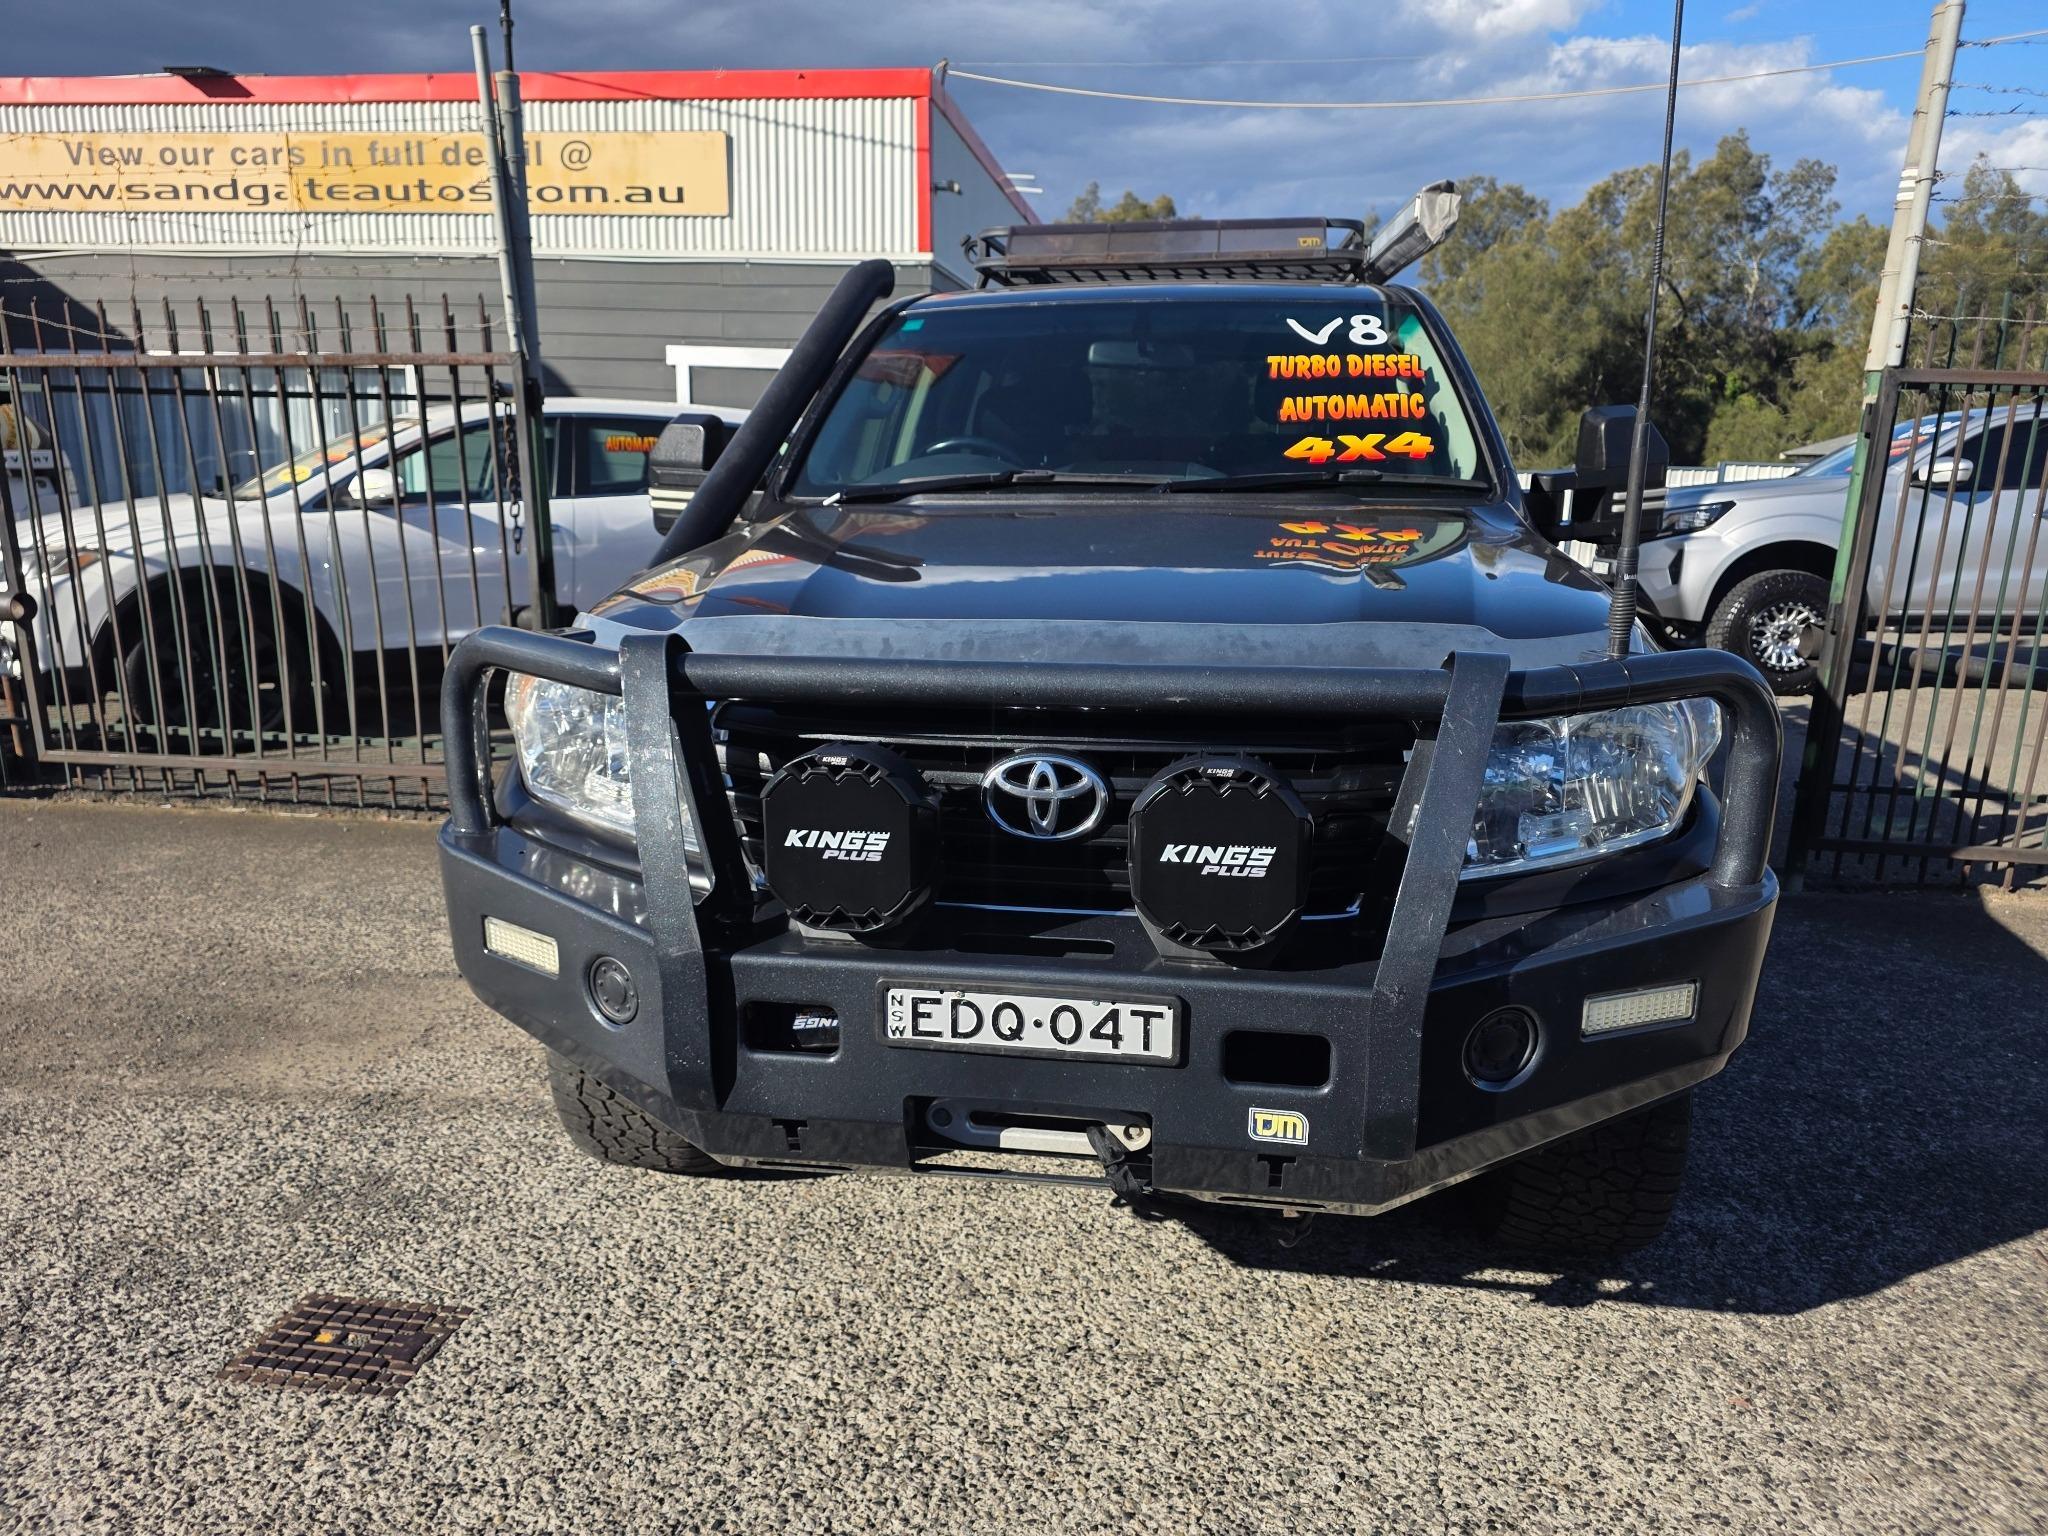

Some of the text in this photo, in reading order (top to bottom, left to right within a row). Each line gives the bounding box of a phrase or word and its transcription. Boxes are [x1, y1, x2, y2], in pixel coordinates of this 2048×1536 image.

[64, 140, 592, 171] View our cars in full deil @
[1286, 314, 1388, 346] V8
[1267, 354, 1425, 380] TURBO DIESEL
[1280, 393, 1426, 421] AUTOMATIC
[822, 756, 848, 764] KINGS
[1206, 768, 1235, 776] KINGS
[784, 829, 891, 851] KINGS
[822, 849, 883, 862] PLUS
[1159, 844, 1277, 867] KINGS
[1201, 865, 1268, 878] PLUS
[889, 994, 907, 1038] NSW
